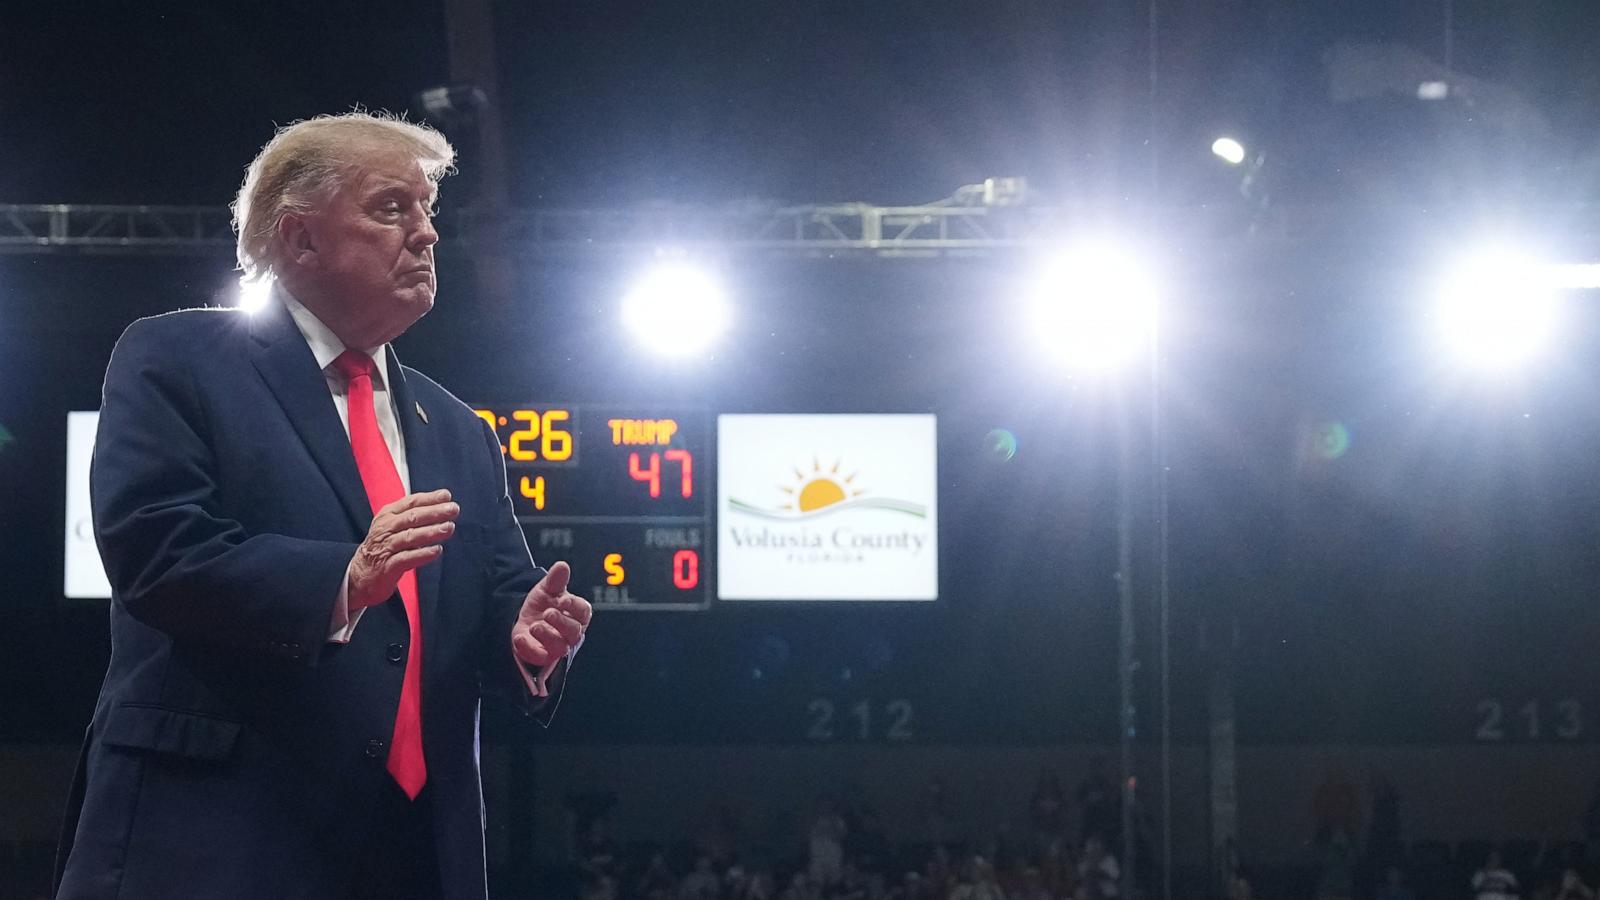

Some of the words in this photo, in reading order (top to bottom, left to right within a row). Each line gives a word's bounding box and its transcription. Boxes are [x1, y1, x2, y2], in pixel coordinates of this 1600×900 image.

[474, 409, 572, 461] :26
[608, 419, 678, 445] TRUMP
[520, 475, 545, 510] 4
[629, 449, 692, 498] 47
[645, 528, 700, 547] FOULS
[730, 526, 823, 548] Volusia
[831, 526, 927, 557] County
[673, 550, 698, 589] 0
[808, 698, 913, 739] 212
[1476, 698, 1584, 739] 213
